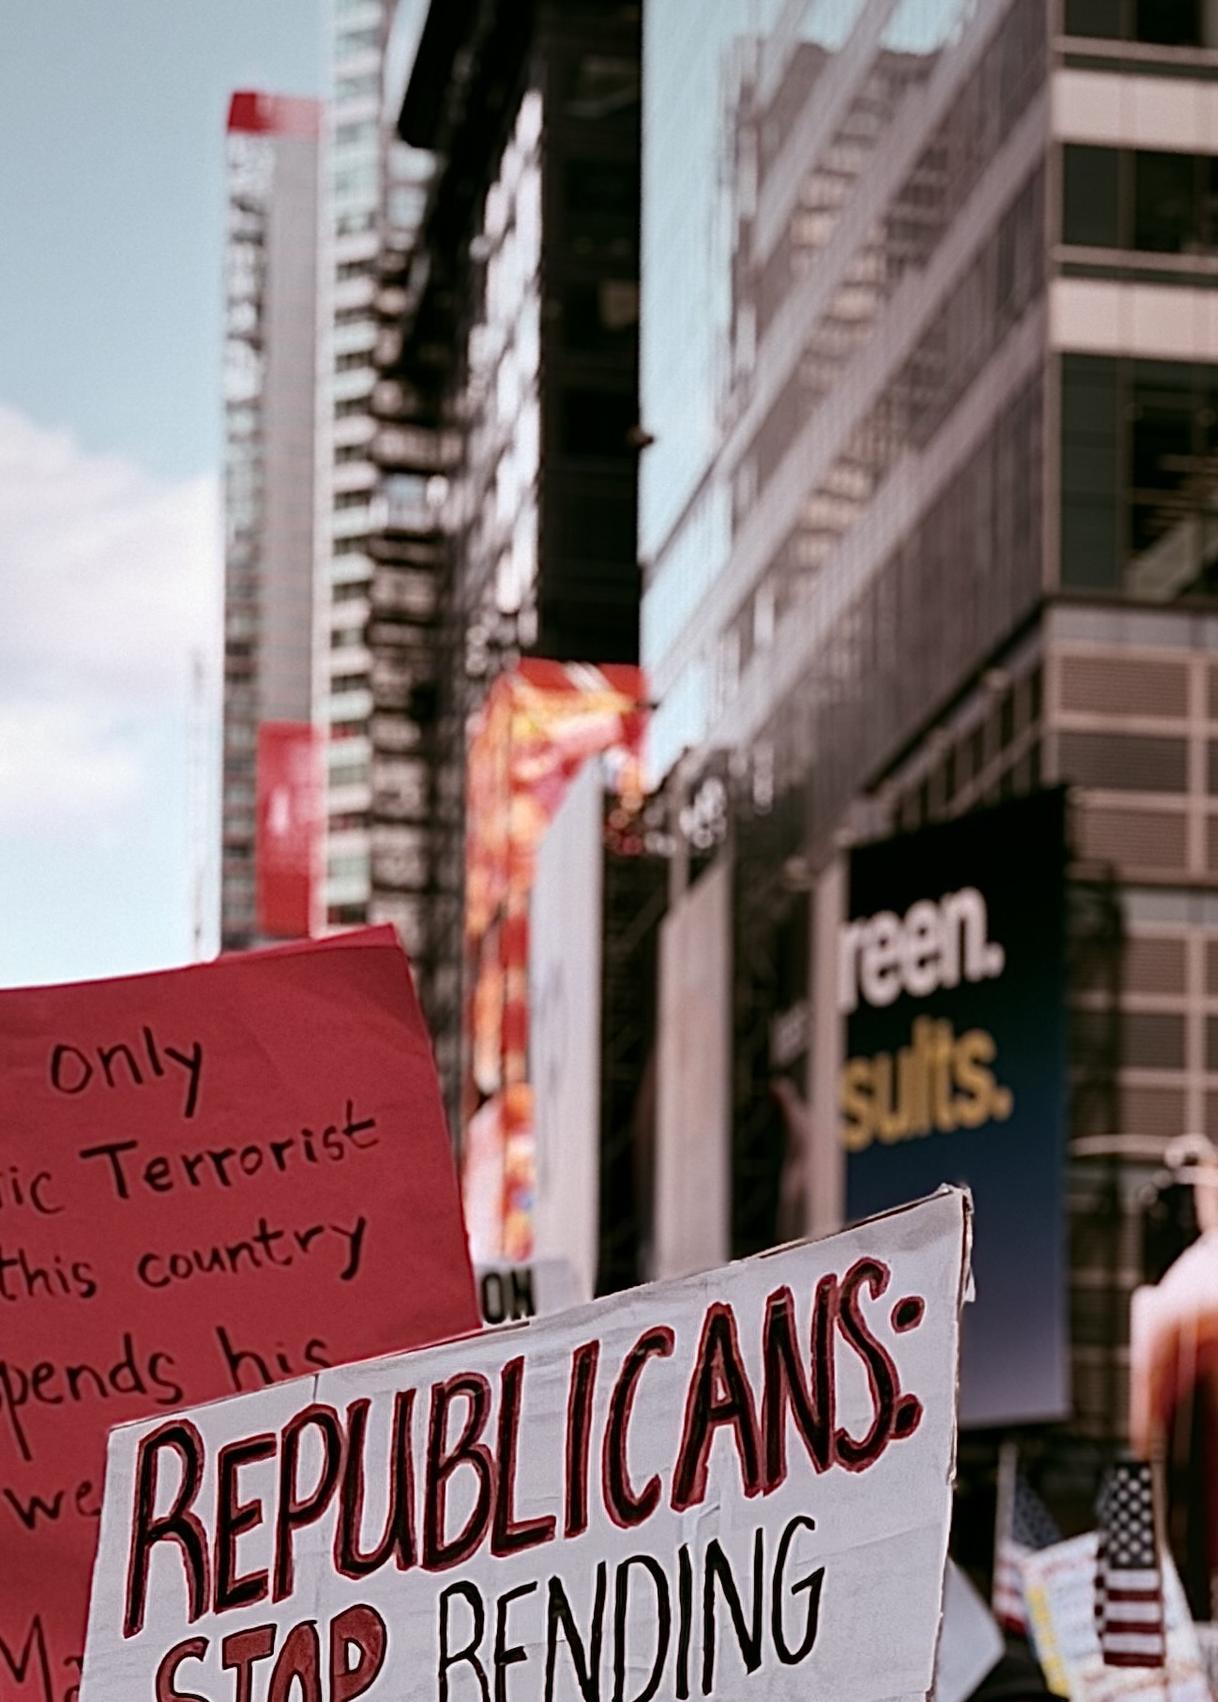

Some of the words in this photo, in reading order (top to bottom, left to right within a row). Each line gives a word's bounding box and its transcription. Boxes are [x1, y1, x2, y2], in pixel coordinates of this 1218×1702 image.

[836, 887, 1006, 1012] reen.
[50, 1025, 203, 1119] Only
[839, 1014, 1014, 1153] sults.
[0, 1165, 66, 1215] ic
[79, 1100, 382, 1199] Terrorist
[0, 1246, 97, 1301] this
[137, 1216, 367, 1281] country
[0, 1332, 184, 1461] pends
[216, 1325, 333, 1392] his
[123, 1255, 926, 1640] REPUBLICANS:
